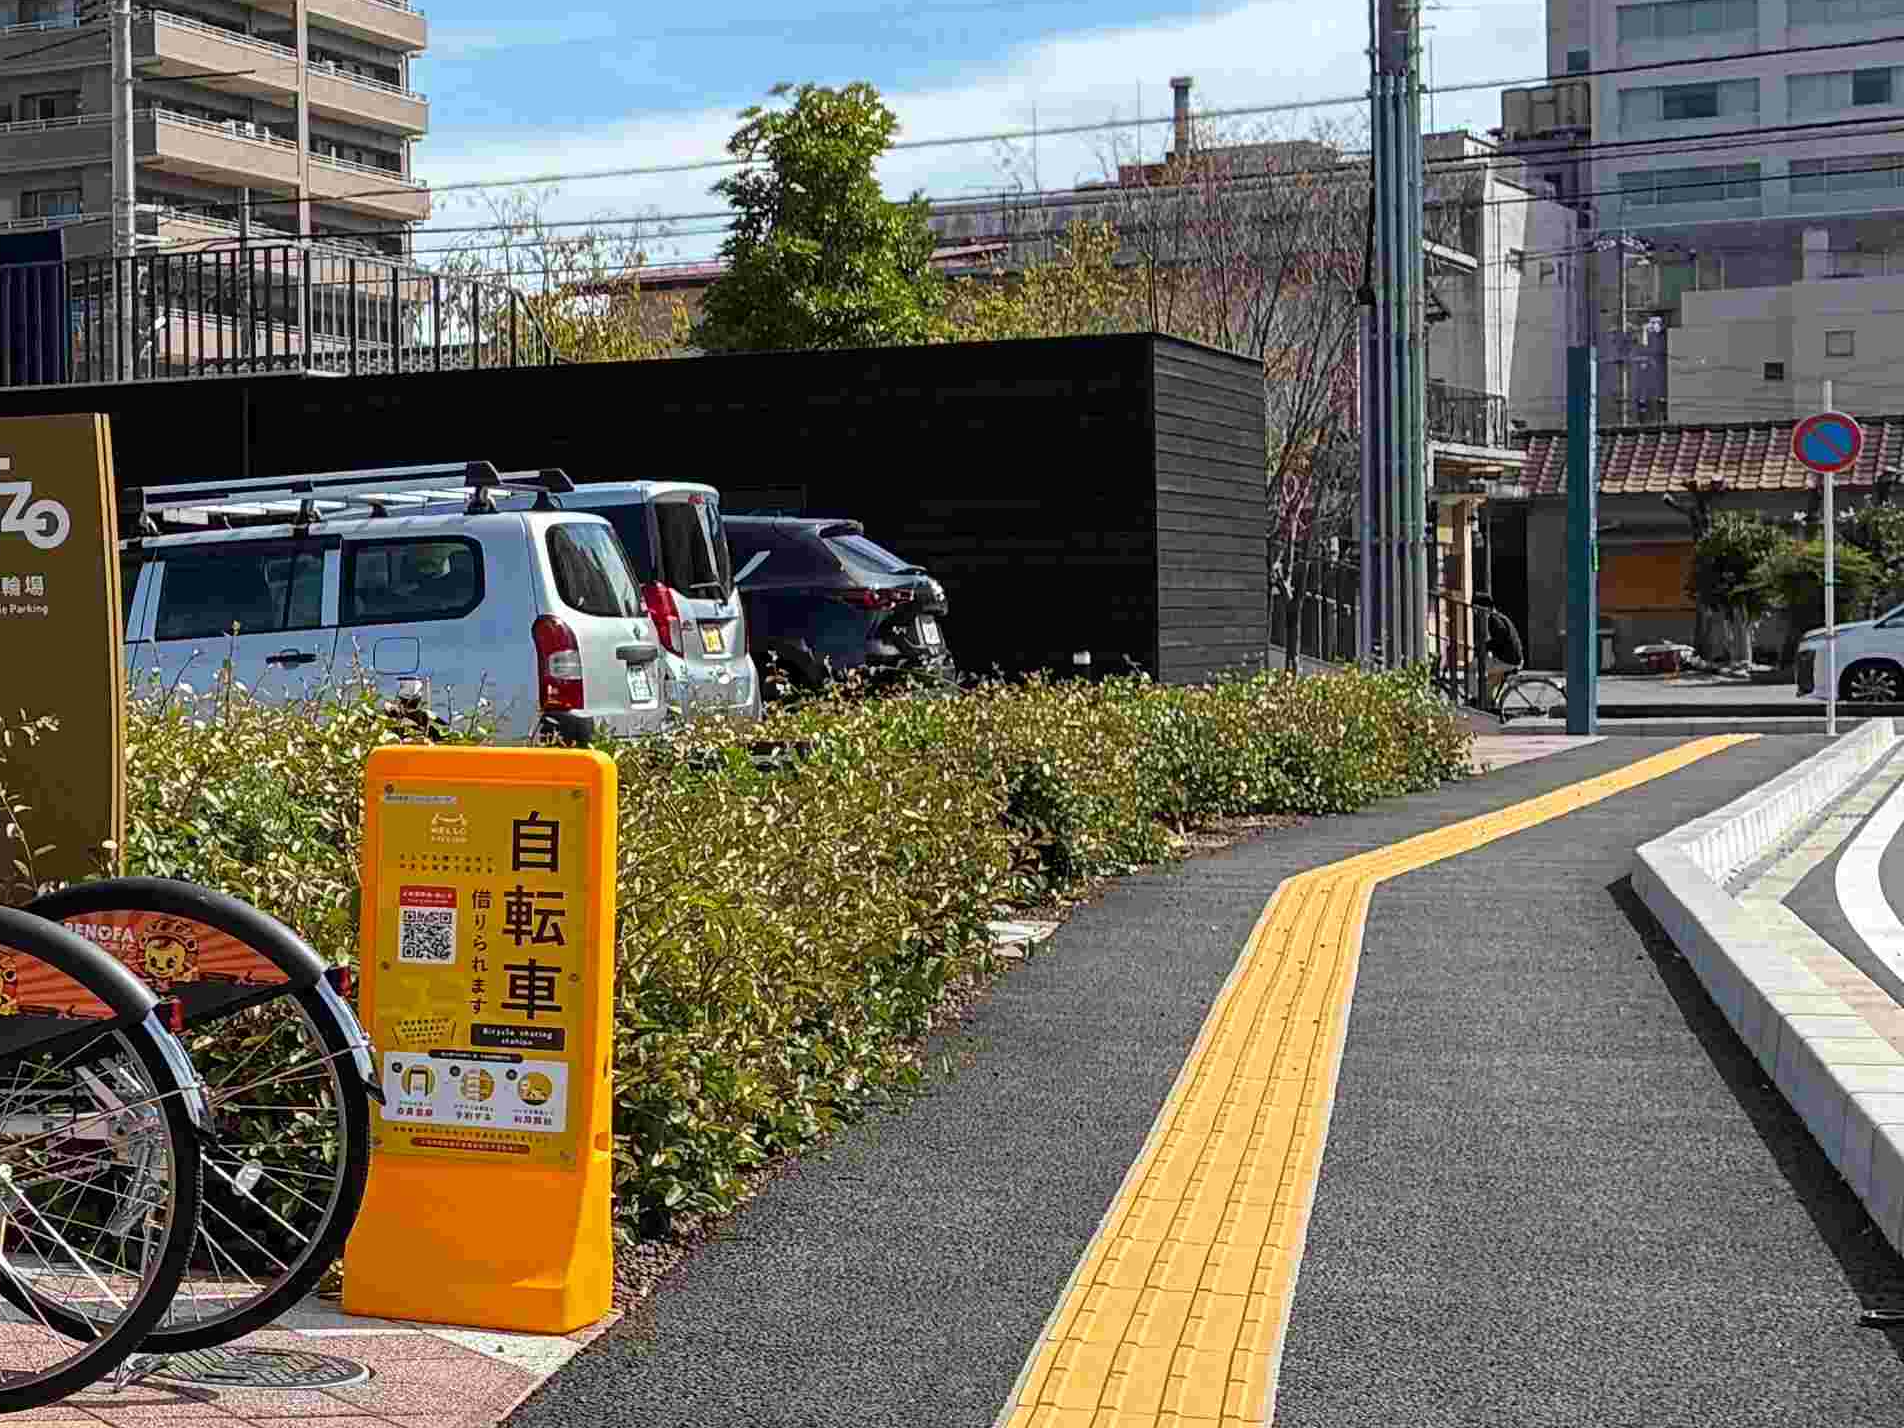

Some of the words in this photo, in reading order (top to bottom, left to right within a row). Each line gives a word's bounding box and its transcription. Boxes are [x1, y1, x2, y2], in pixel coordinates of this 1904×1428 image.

[9, 603, 49, 616] Parking
[468, 888, 492, 1015] 借りられます
[501, 810, 566, 1020] 自転車
